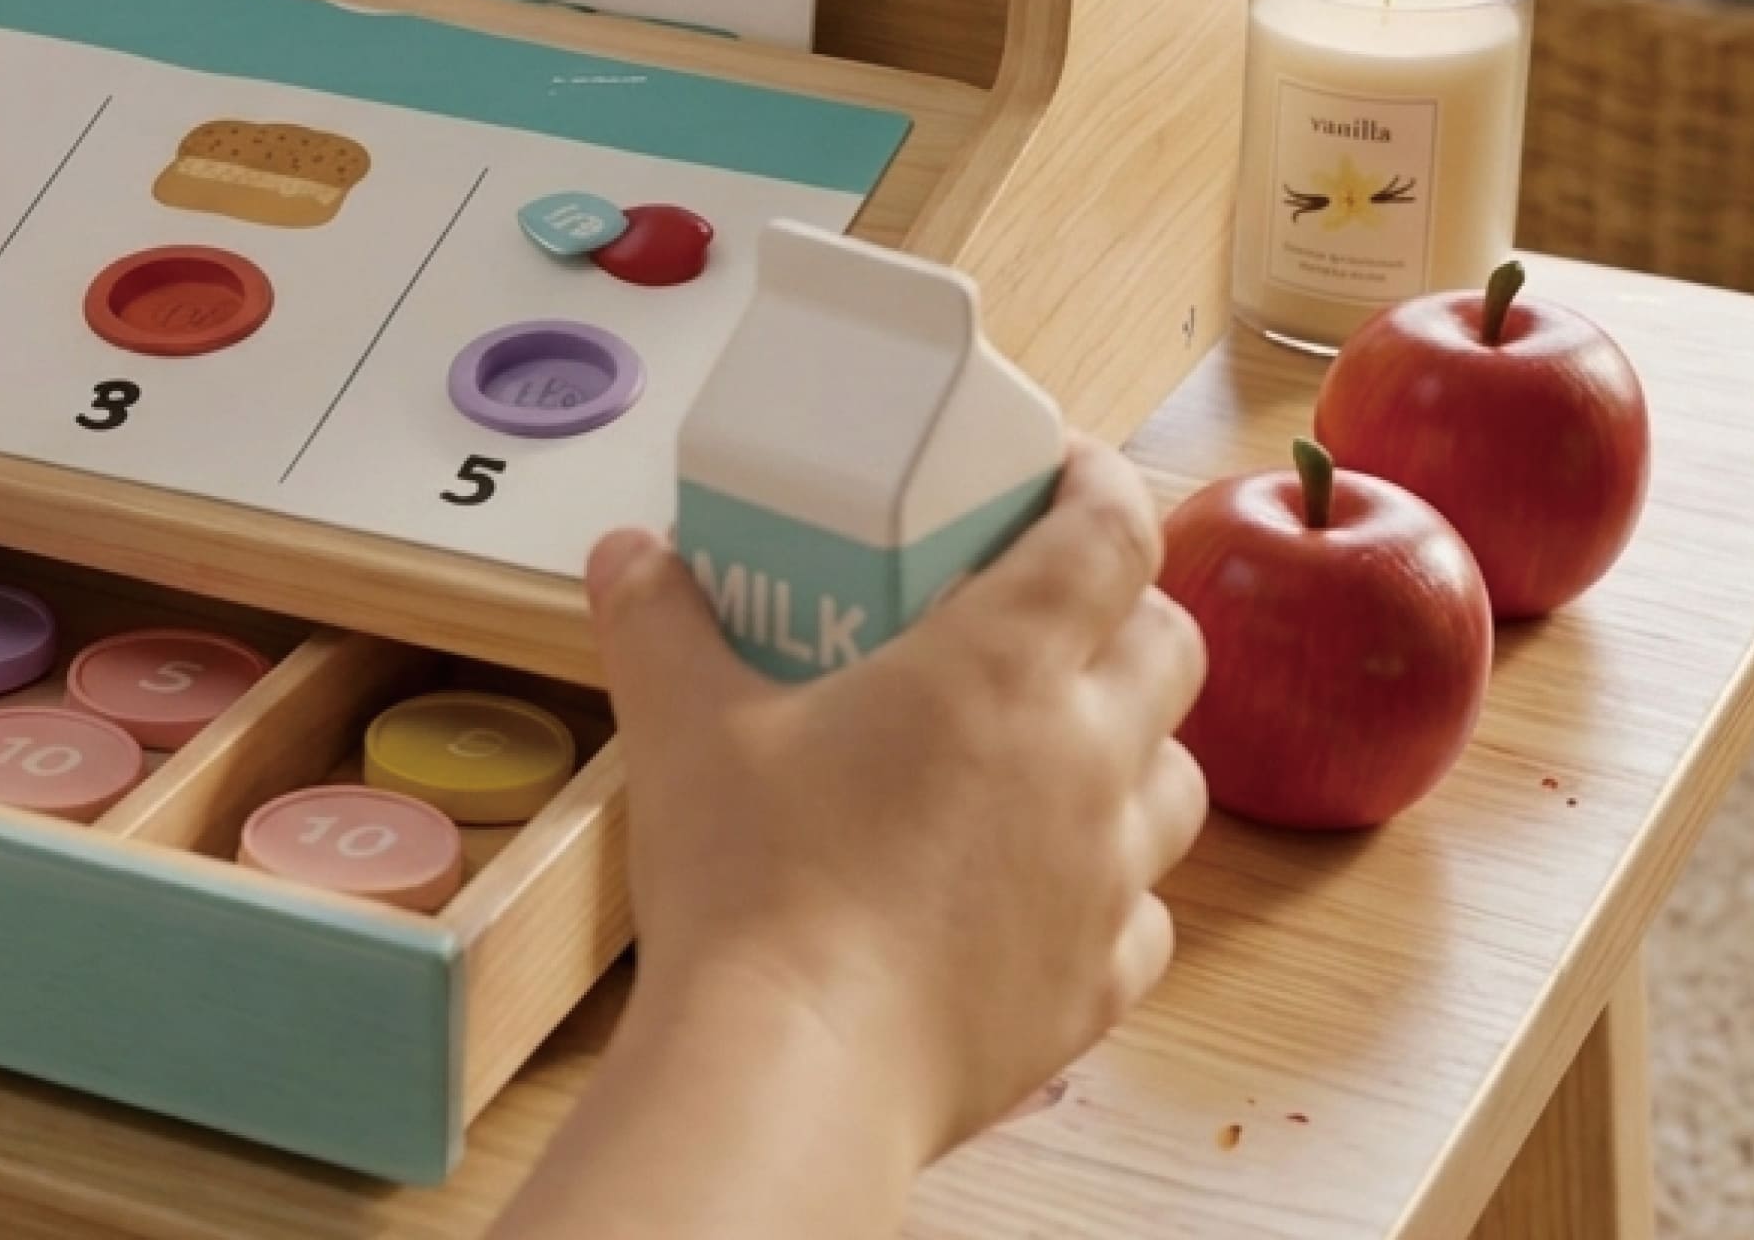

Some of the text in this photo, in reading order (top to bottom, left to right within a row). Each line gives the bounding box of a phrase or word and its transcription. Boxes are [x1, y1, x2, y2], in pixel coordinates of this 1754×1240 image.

[1309, 116, 1391, 144] vanilla
[439, 453, 507, 507] 5
[136, 660, 197, 695] 5
[298, 812, 399, 859] 10
